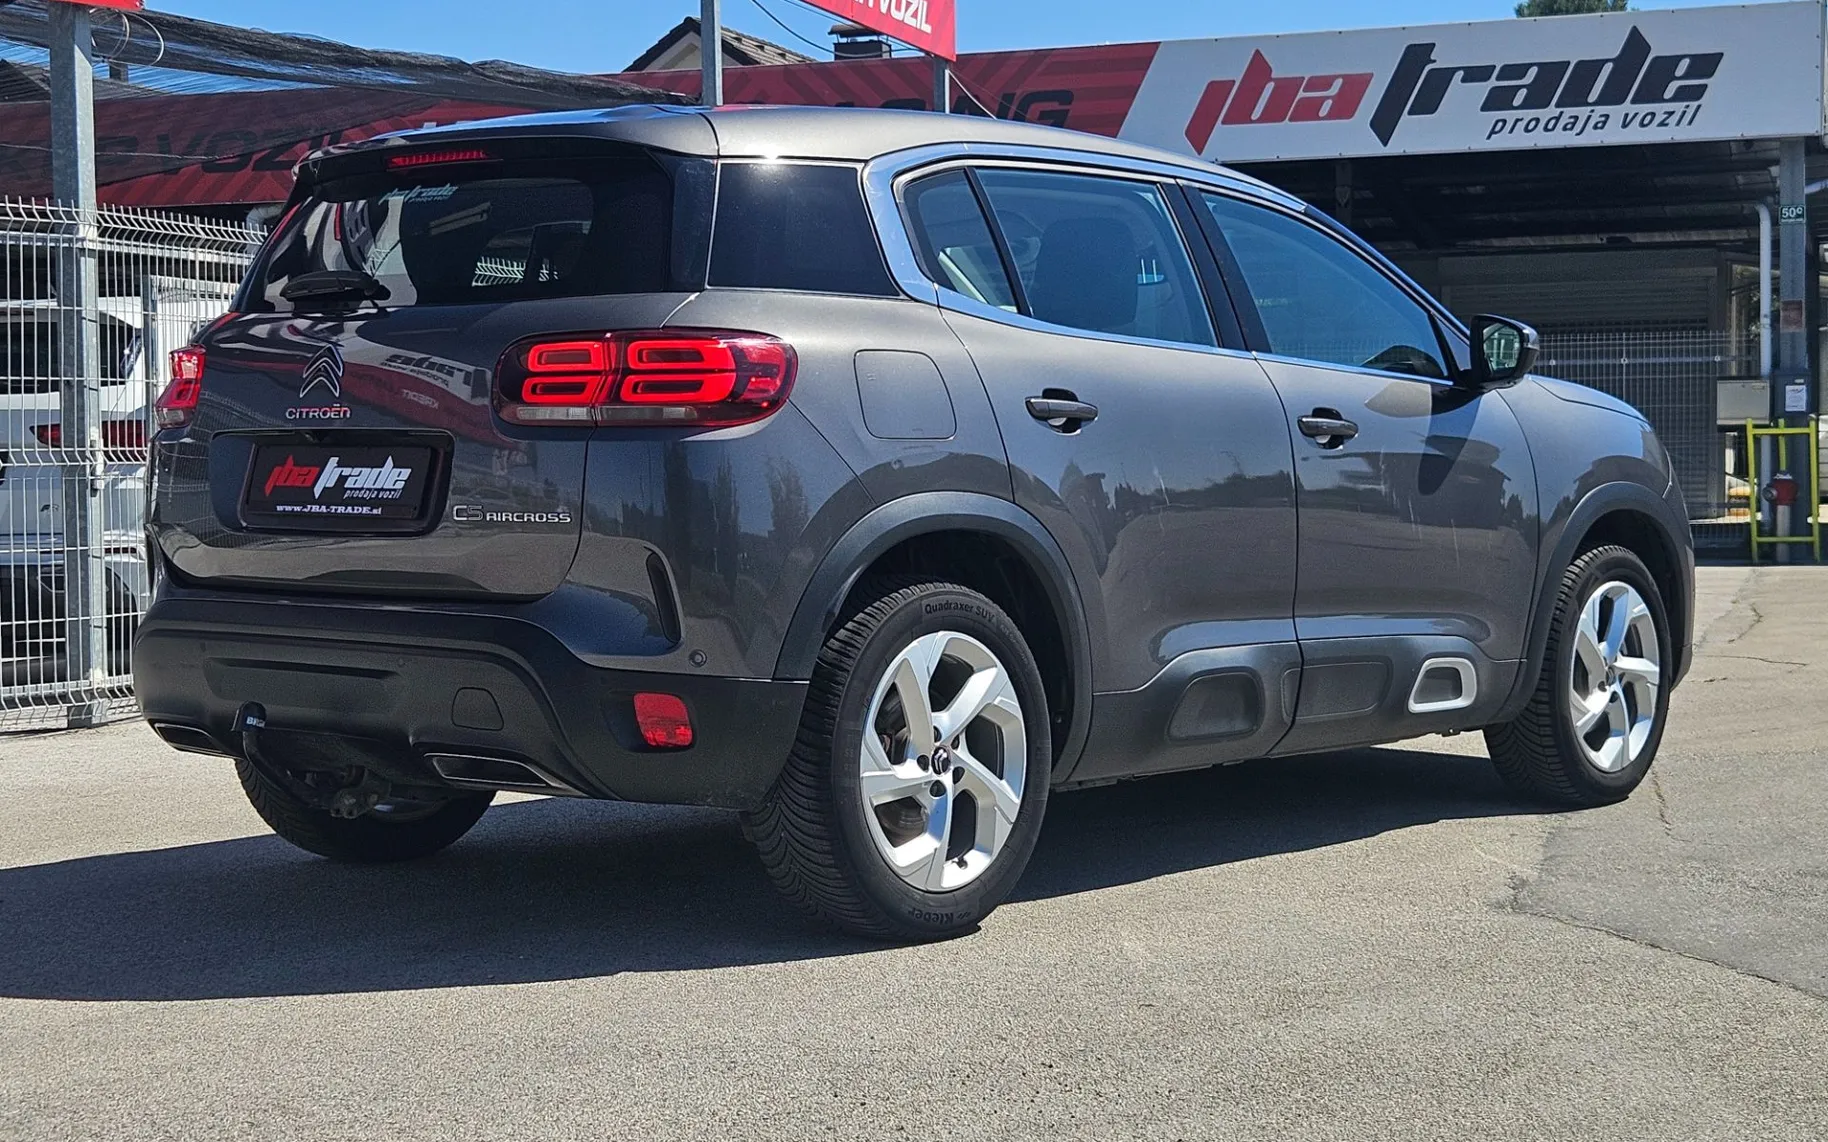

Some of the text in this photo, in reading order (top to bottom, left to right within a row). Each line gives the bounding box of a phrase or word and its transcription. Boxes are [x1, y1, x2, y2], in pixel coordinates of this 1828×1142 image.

[1184, 25, 1725, 155] jba trade
[1486, 104, 1703, 140] prodaja vozil
[313, 455, 412, 500] trade
[343, 489, 403, 500] prodaja vozil
[276, 504, 382, 515] www.JBA-TRADE.si
[453, 504, 571, 523] C5 AIRCROSS
[925, 600, 996, 623] Quadraxer SUV
[908, 908, 954, 924] Kleber
